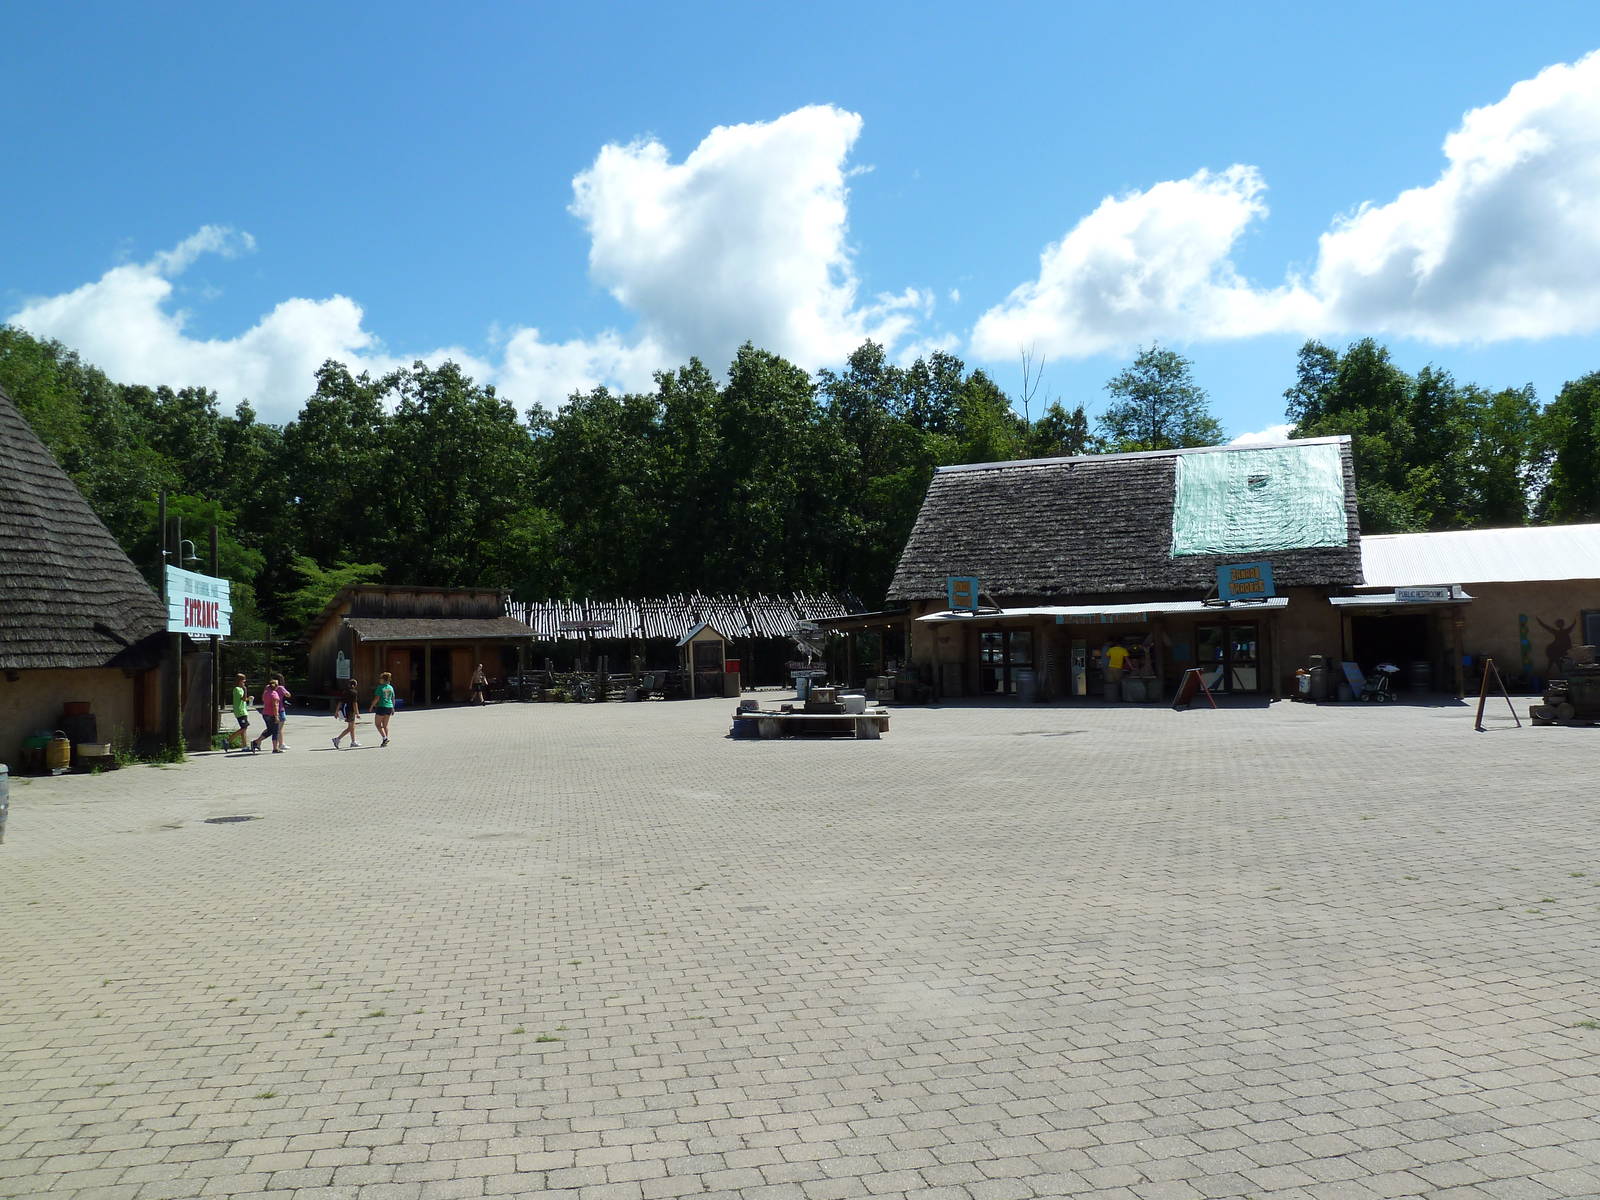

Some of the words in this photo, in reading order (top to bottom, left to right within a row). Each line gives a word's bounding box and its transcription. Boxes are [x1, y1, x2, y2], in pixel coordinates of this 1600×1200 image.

[1398, 590, 1416, 598] PUBLIC
[1416, 590, 1444, 598] RESTROOMS
[184, 596, 219, 630] ENTRANCE
